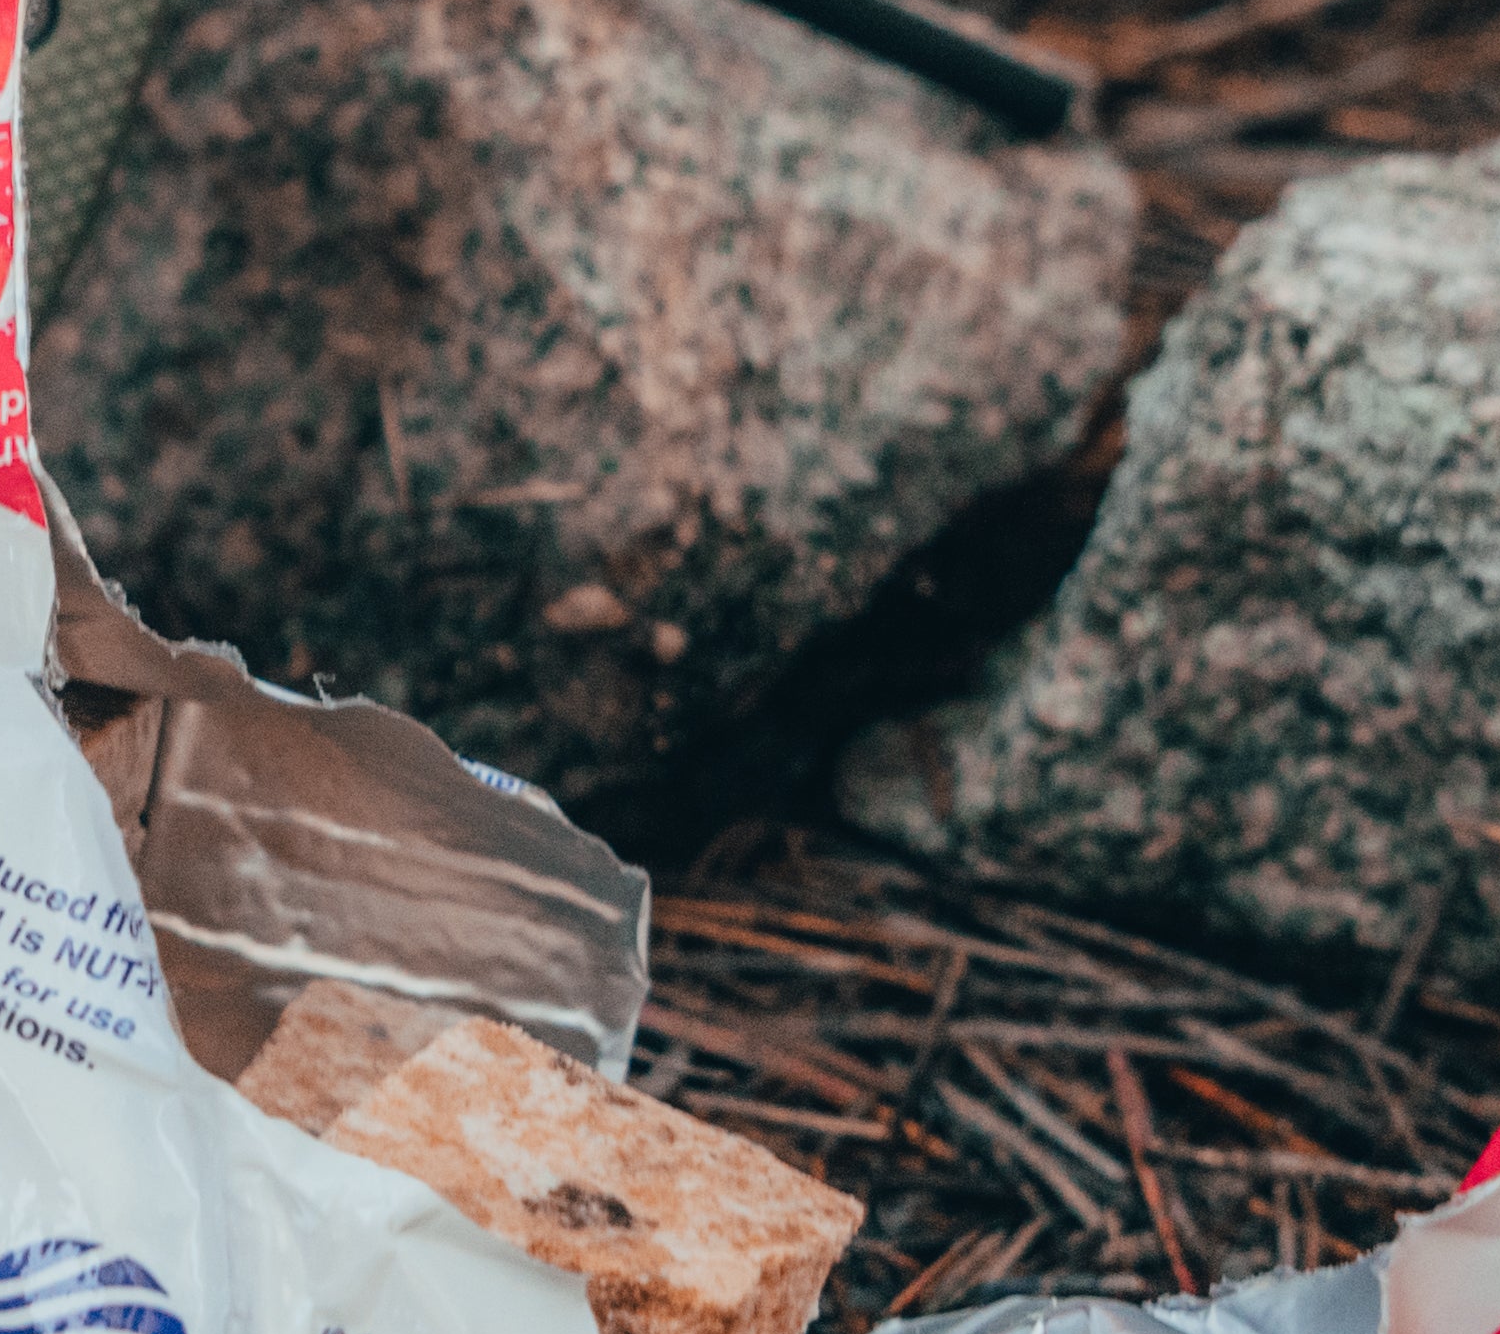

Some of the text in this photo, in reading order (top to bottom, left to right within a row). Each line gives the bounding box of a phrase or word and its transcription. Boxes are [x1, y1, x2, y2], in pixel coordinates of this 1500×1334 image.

[10, 918, 44, 954] is
[1, 966, 58, 1004] for
[65, 997, 136, 1040] use
